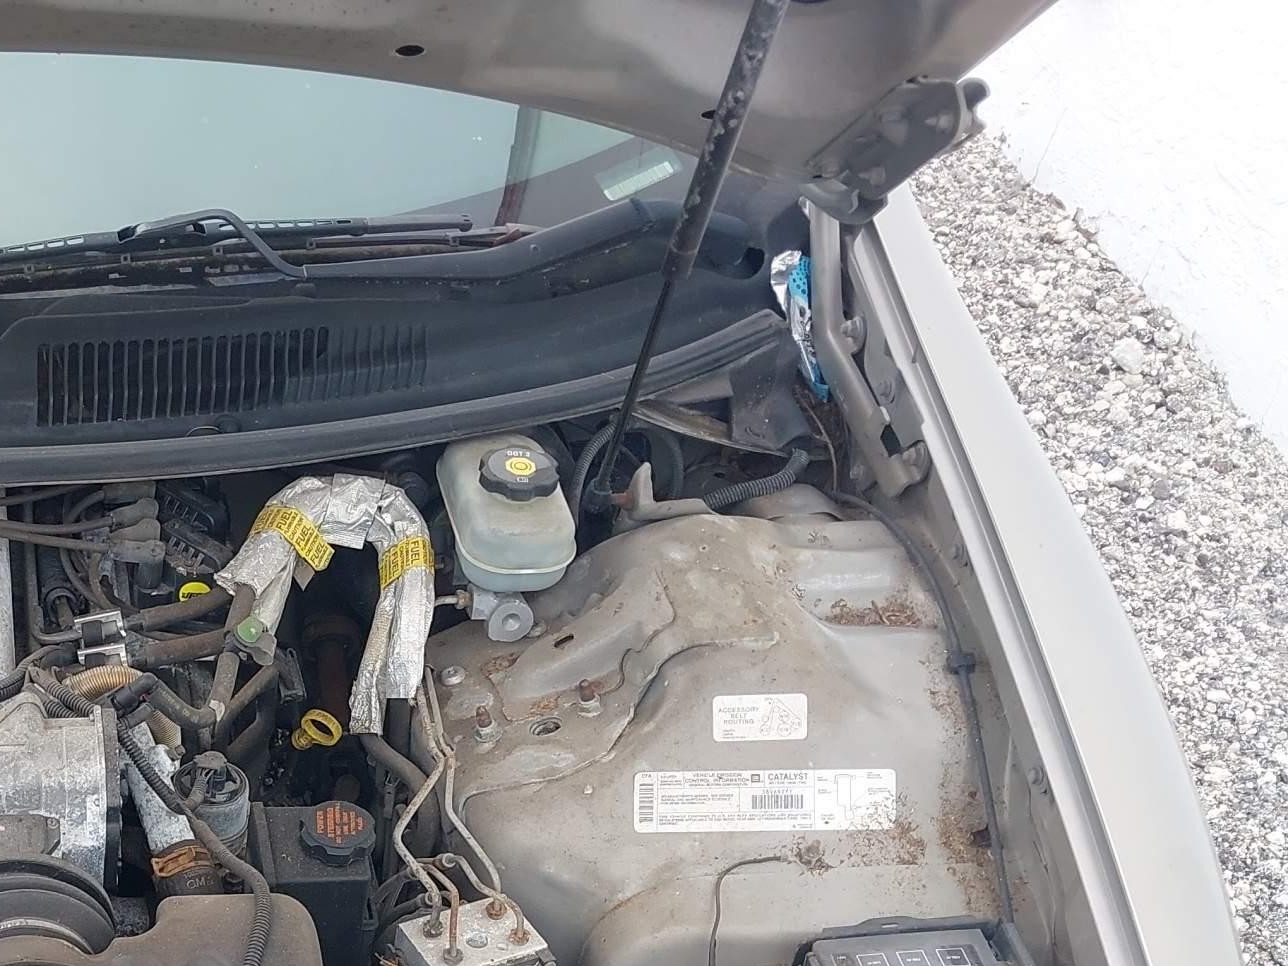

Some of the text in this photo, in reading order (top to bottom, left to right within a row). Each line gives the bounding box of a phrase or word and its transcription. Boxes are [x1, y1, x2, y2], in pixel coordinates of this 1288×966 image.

[276, 510, 293, 530] FUEL
[289, 517, 304, 539] CAUTION
[295, 526, 312, 547] FUEL
[305, 534, 320, 557] CAUTION
[310, 542, 324, 563] FUEL
[412, 540, 421, 563] FUEL
[391, 552, 400, 575] FUEL
